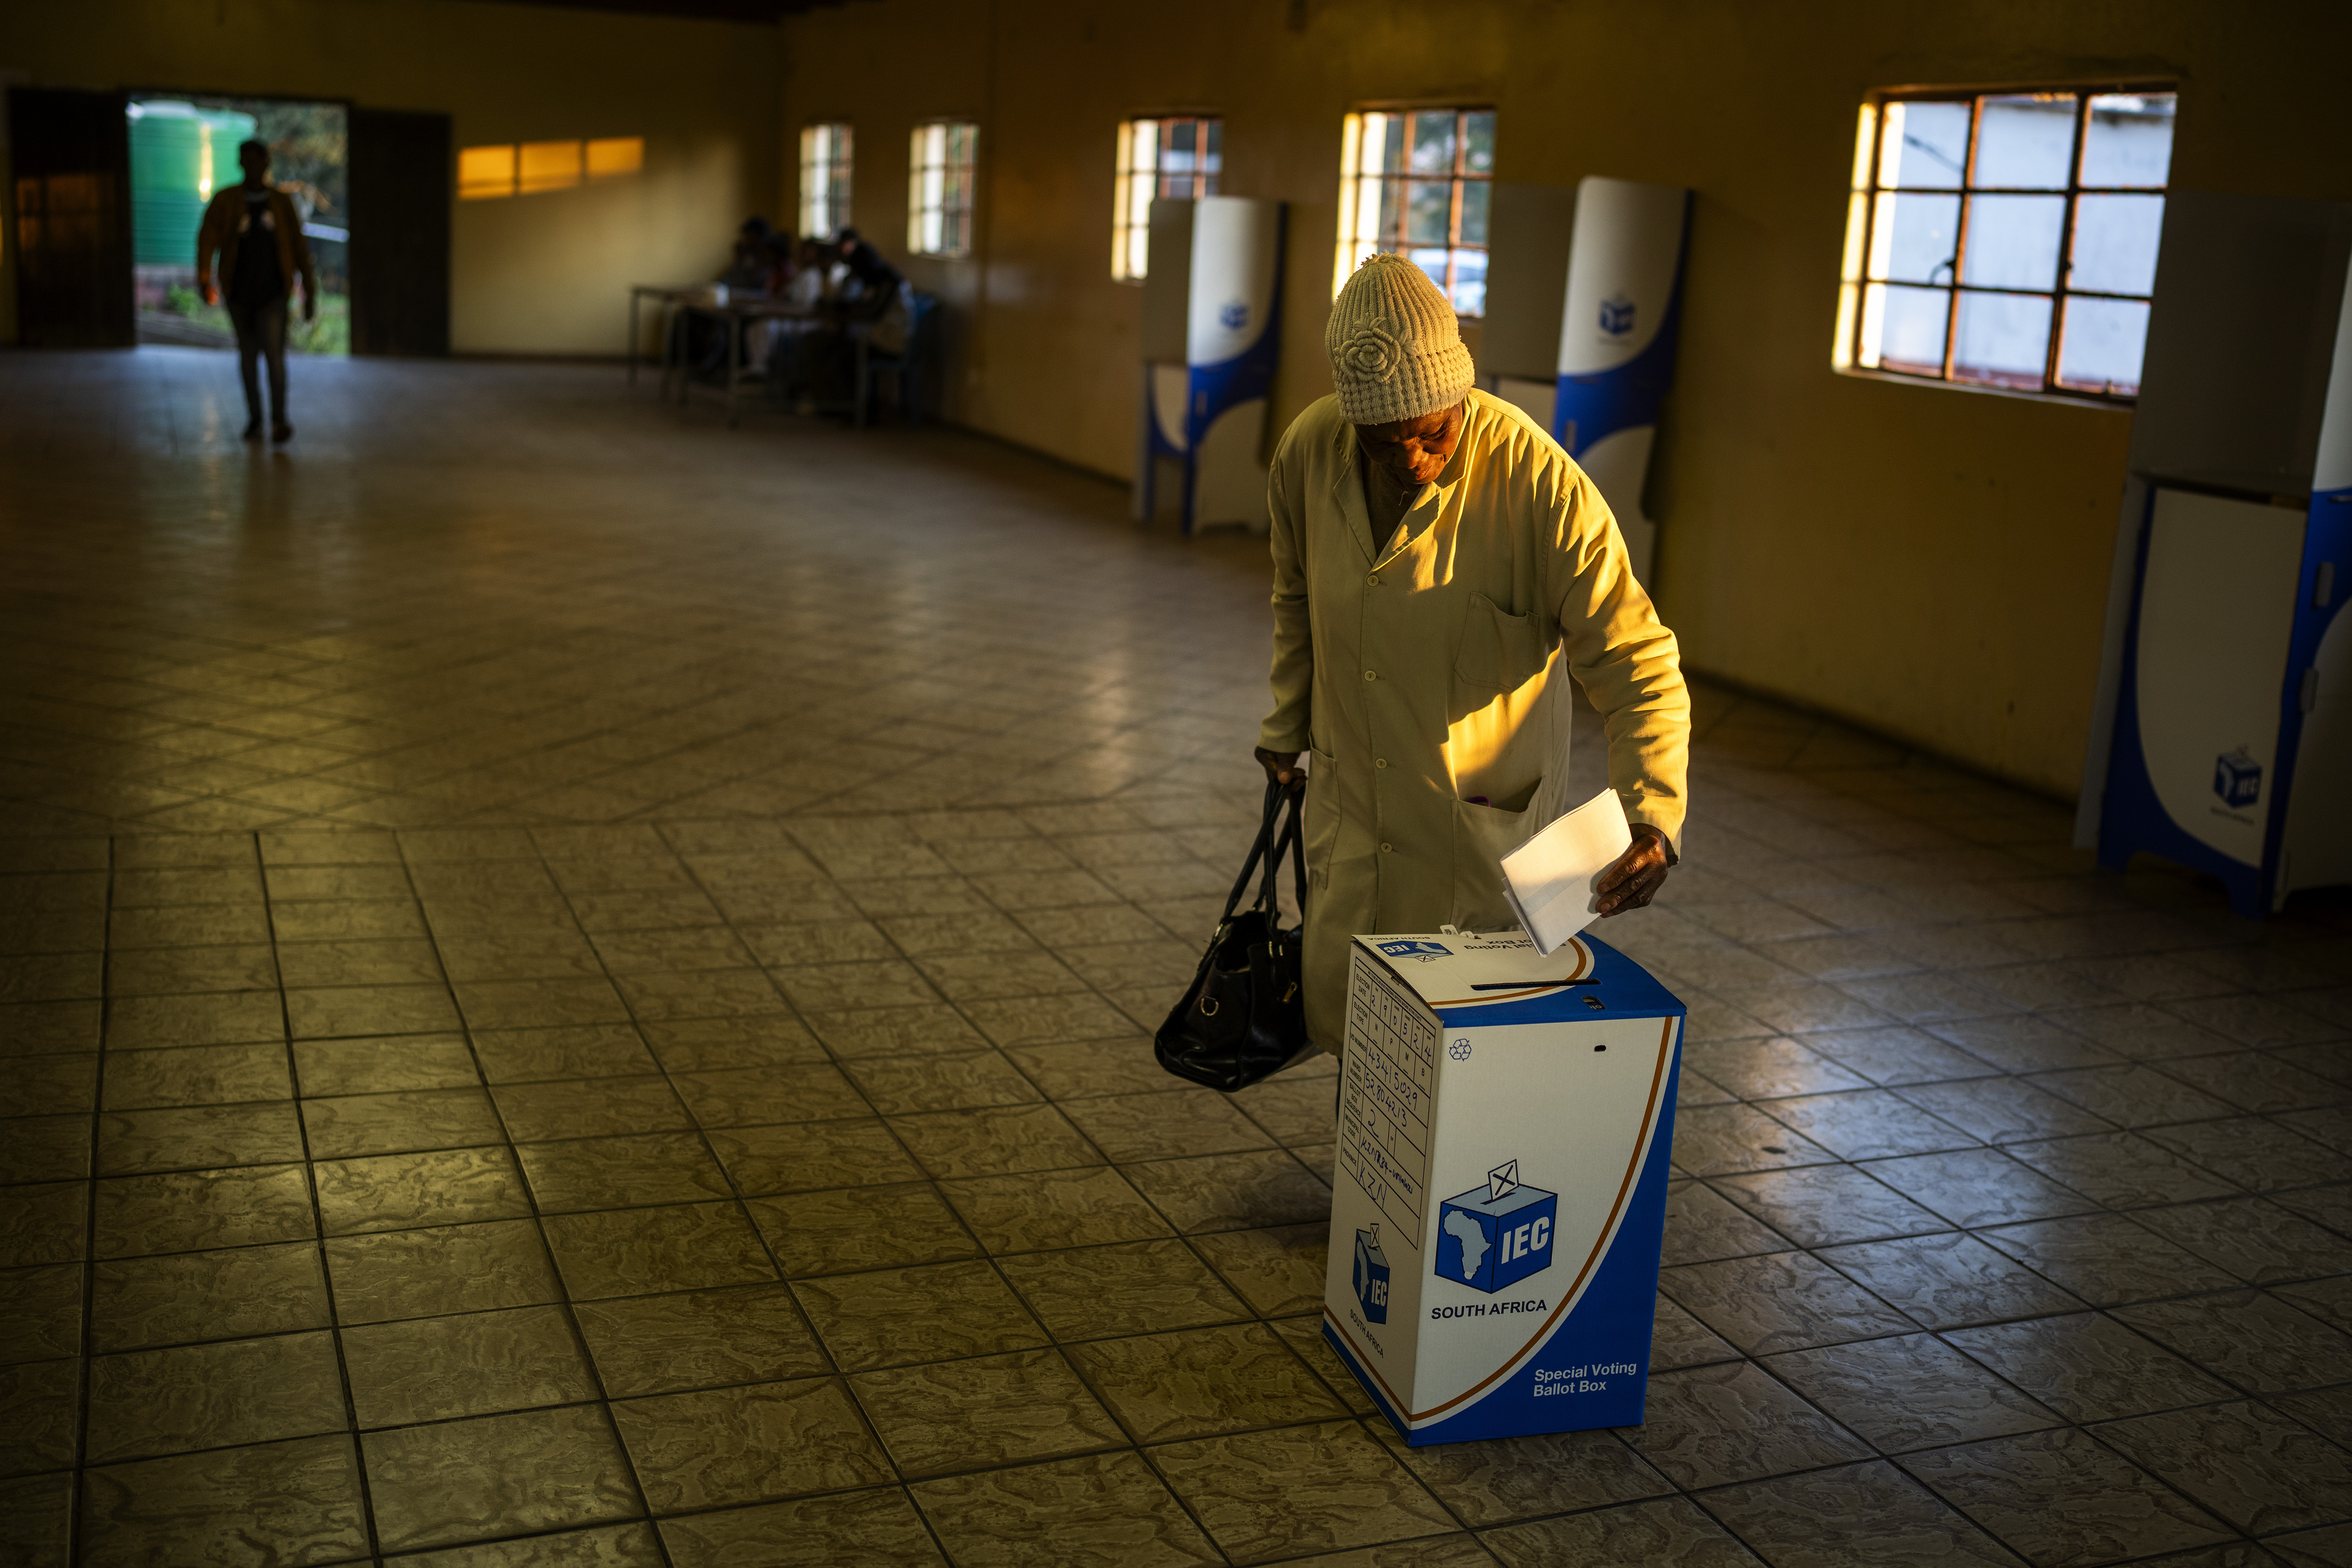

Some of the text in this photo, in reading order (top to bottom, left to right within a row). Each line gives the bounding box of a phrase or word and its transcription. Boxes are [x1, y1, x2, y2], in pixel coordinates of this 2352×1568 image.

[1383, 944, 1410, 953] IEC
[1356, 973, 1370, 990] ELECTION
[1354, 1001, 1368, 1019] ELECTION
[1371, 995, 1431, 1063] 2 9 0 5 2 4
[1350, 1032, 1366, 1053] VD NUMBER
[1375, 1023, 1424, 1076] N P M B
[1350, 1067, 1362, 1084] NUMBER
[1352, 1060, 1360, 1072] WARD
[1350, 1082, 1360, 1098] BALLOT
[1347, 1098, 1361, 1117] SEQUENCE
[1345, 1113, 1359, 1133] MUNICIPAL
[1368, 1109, 1379, 1138] 2
[1343, 1146, 1356, 1166] PROVINCE
[1359, 1160, 1387, 1209] KZN
[1501, 1216, 1550, 1265] IEC
[1371, 1279, 1387, 1307] IEC
[1431, 1299, 1548, 1320] SOUTH AFRICA
[1350, 1309, 1384, 1359] SOUTH AFRICA
[1534, 1362, 1637, 1384] Special Voting
[1533, 1379, 1607, 1397] Ballot Box
